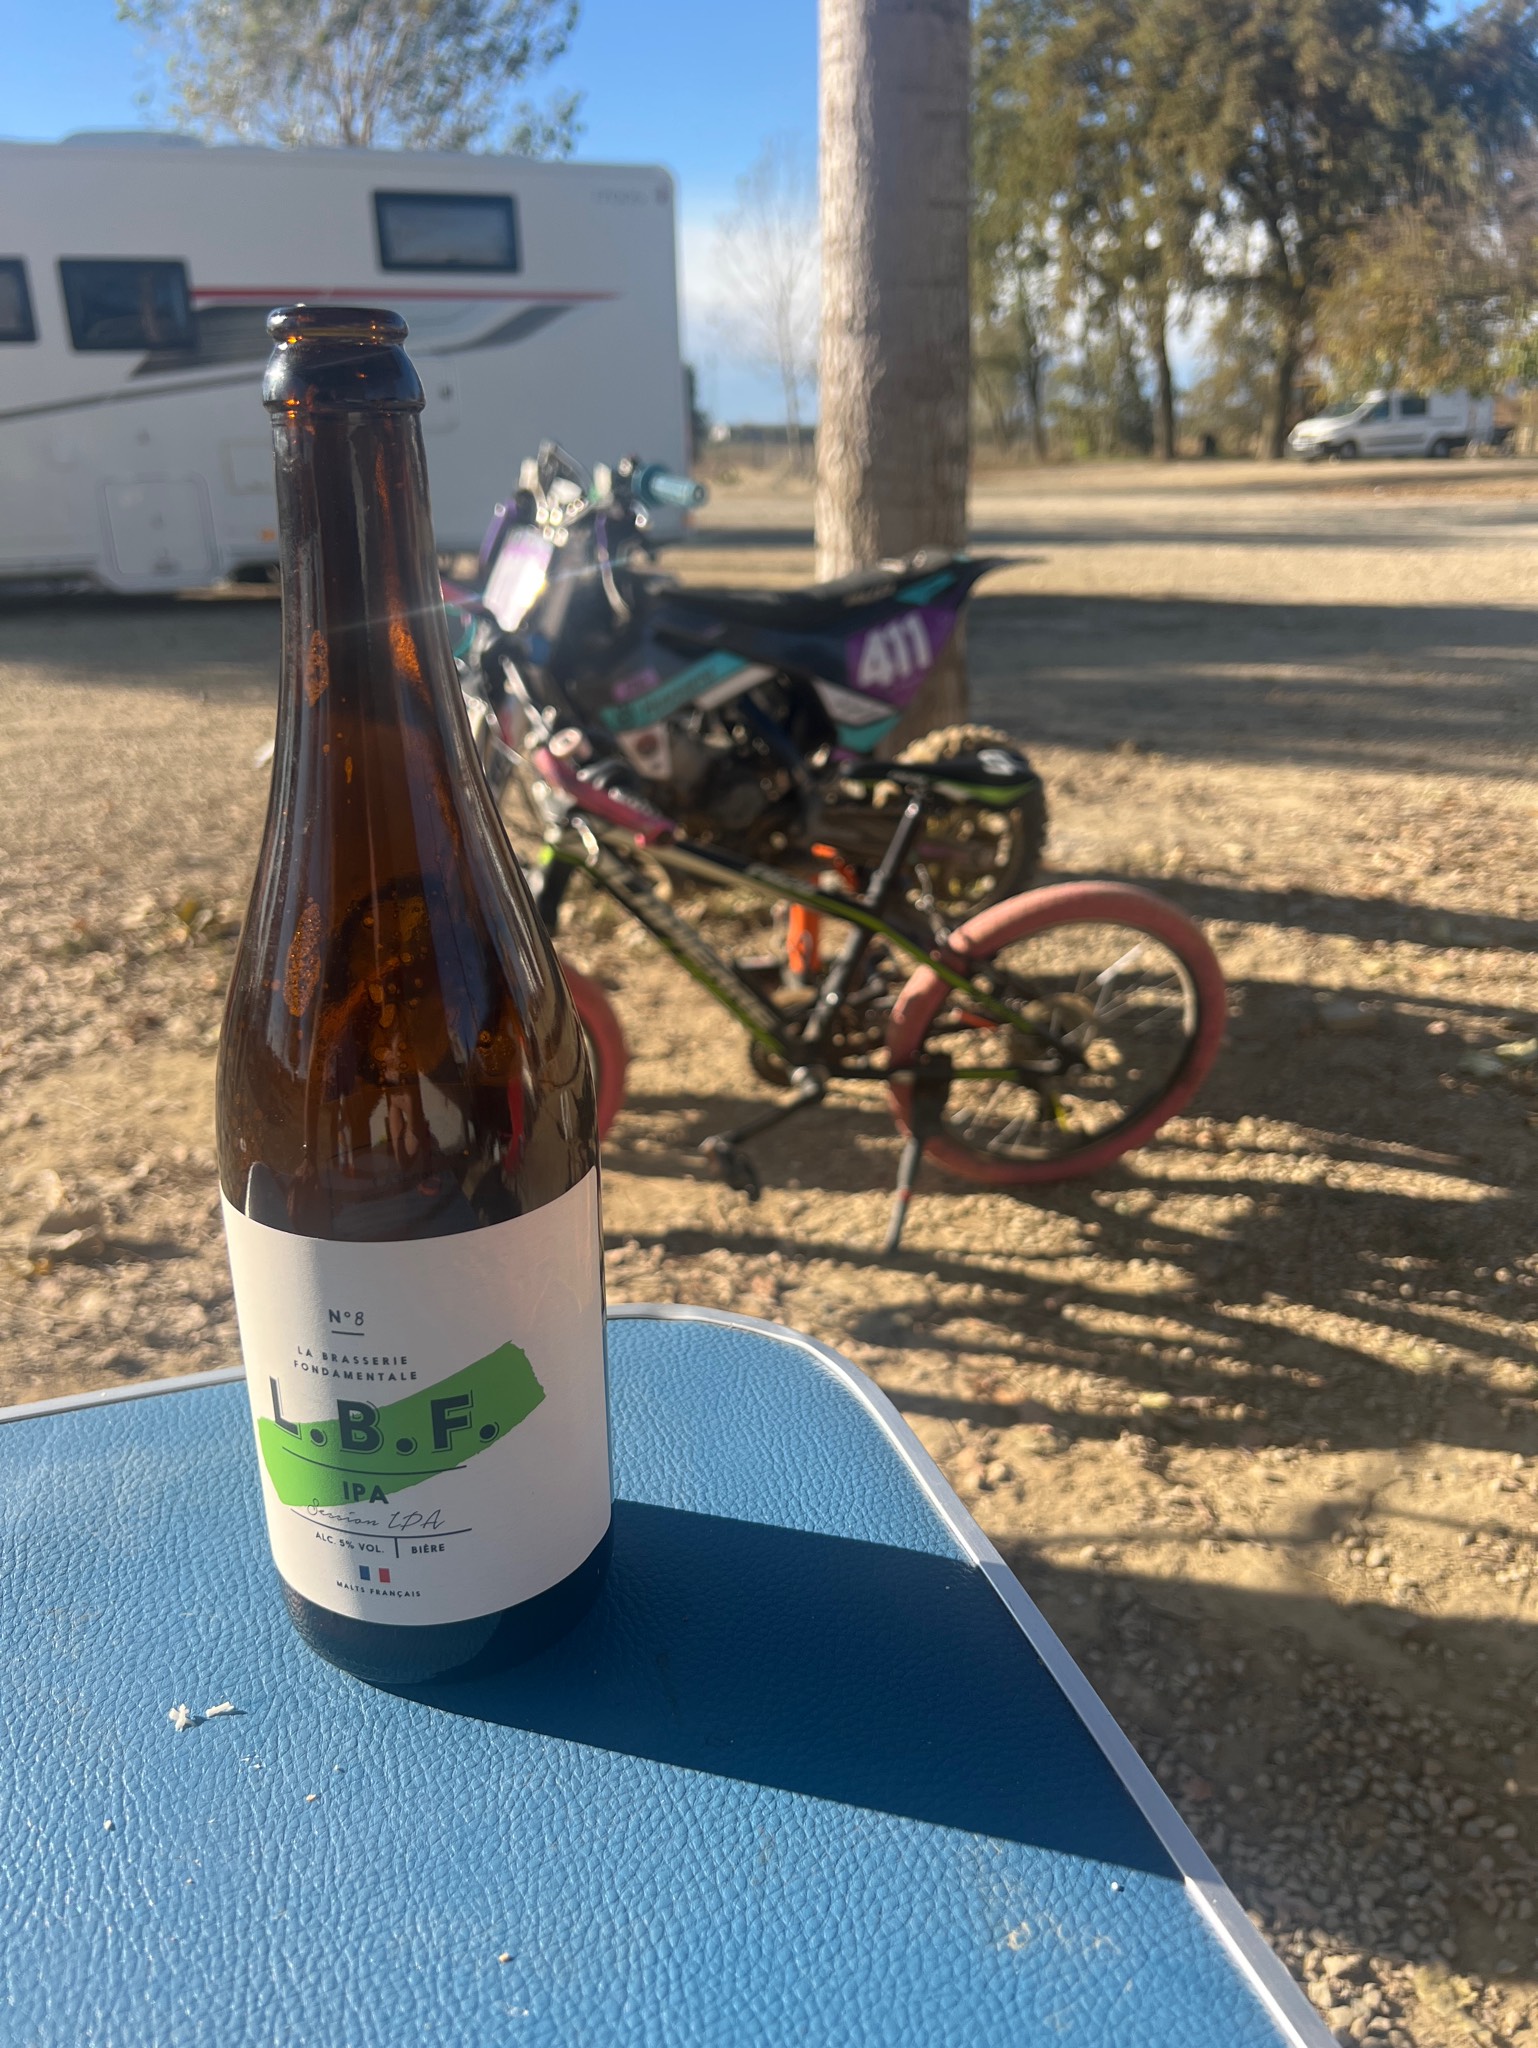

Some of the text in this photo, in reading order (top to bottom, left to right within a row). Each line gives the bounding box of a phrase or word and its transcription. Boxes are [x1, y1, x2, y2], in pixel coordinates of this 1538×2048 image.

[856, 611, 932, 688] 411
[297, 1345, 408, 1366] LA BRASSERIE
[293, 1359, 418, 1382] FONDAMENTALE
[342, 1480, 390, 1505] IPA
[306, 1497, 380, 1528] Session
[315, 1531, 385, 1554] ALC. 5% VOL.
[336, 1580, 422, 1599] MALTS FRANÇAIS
